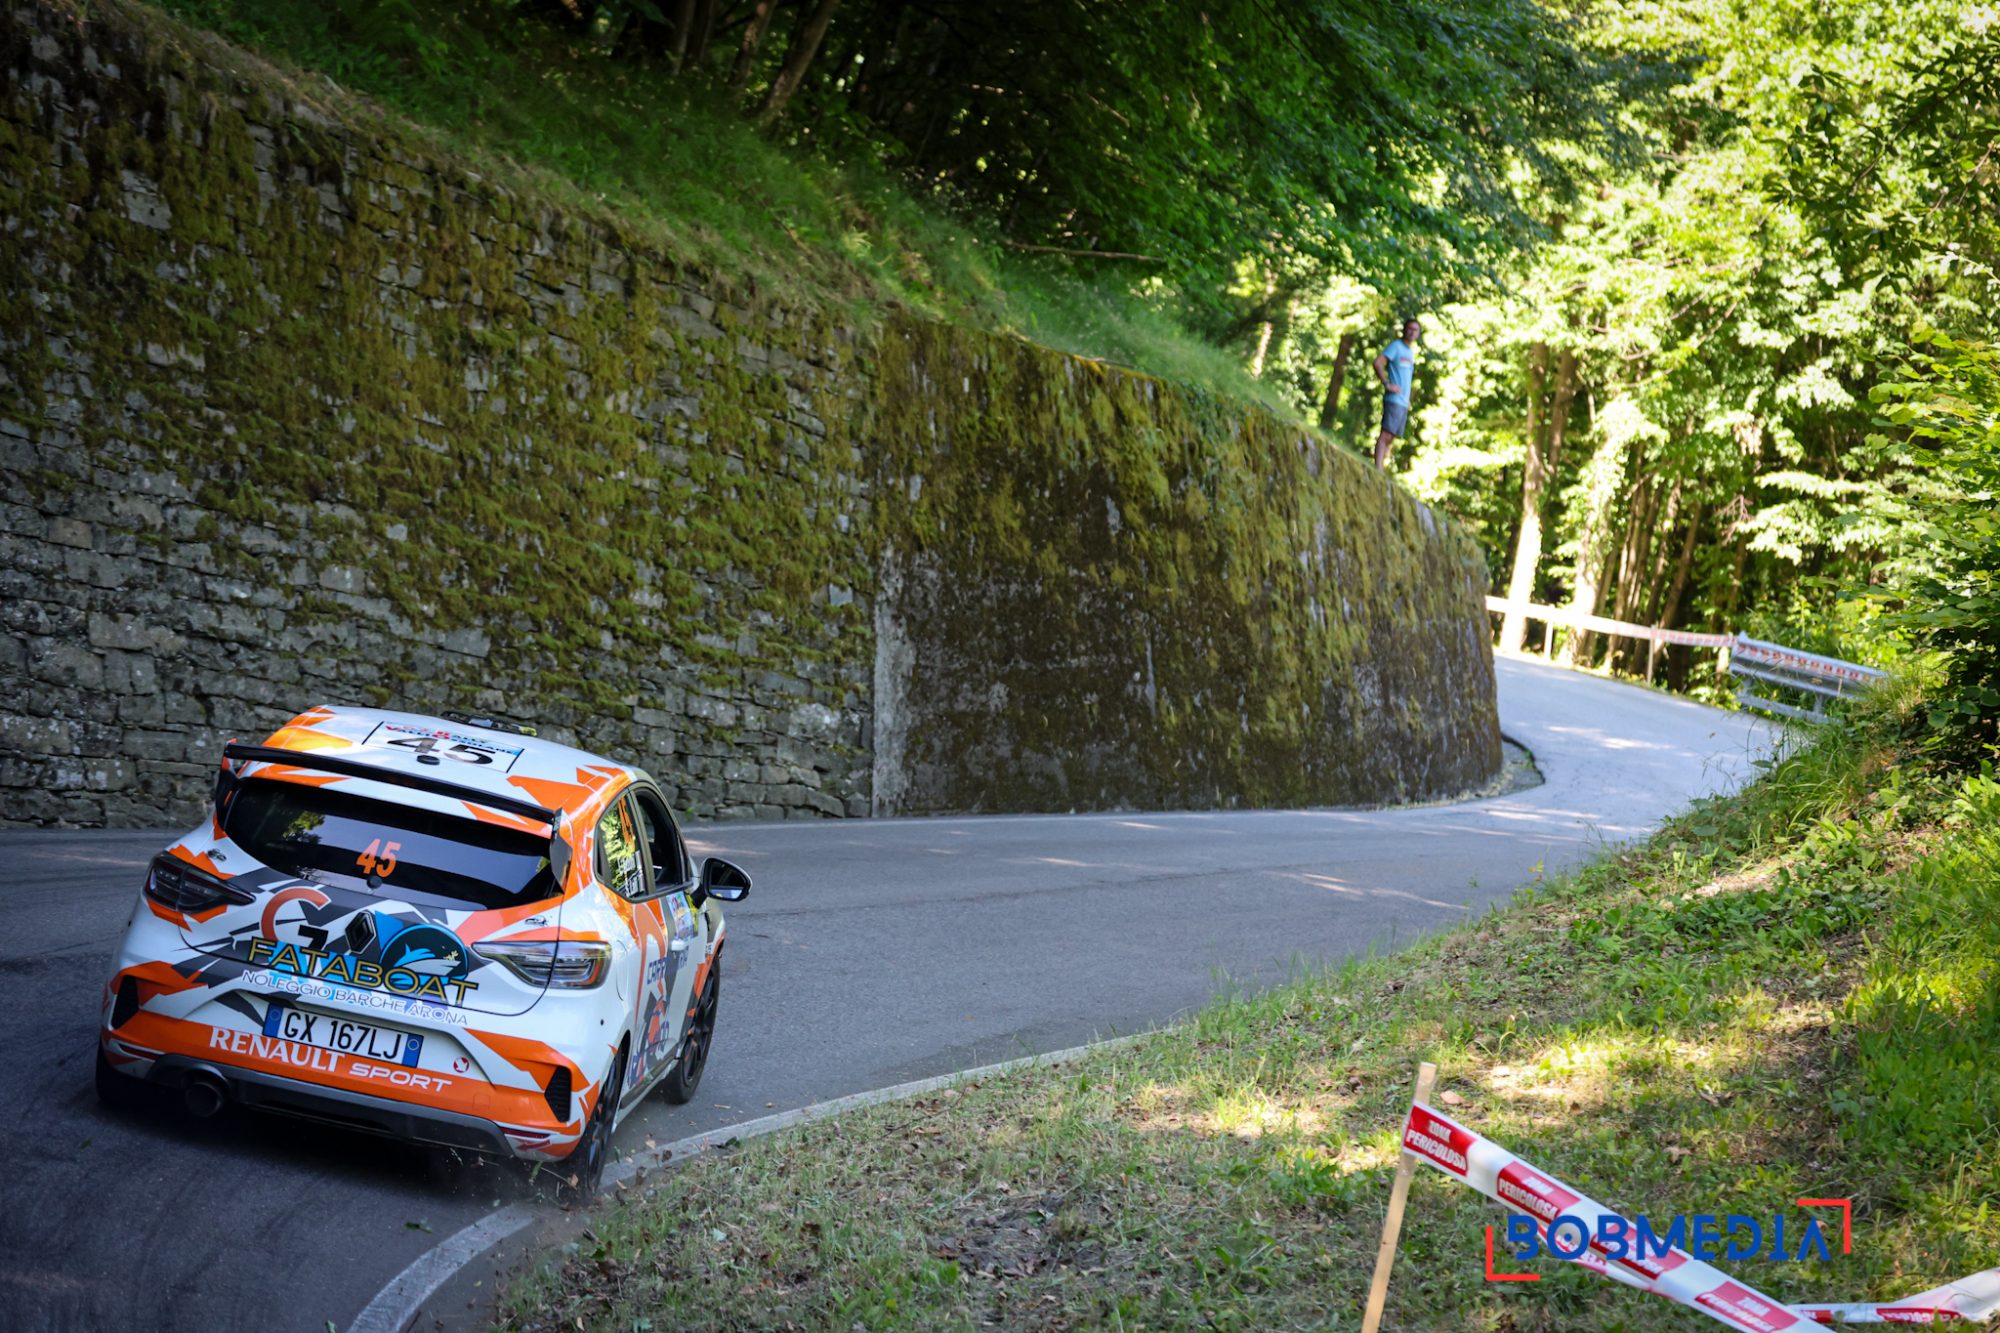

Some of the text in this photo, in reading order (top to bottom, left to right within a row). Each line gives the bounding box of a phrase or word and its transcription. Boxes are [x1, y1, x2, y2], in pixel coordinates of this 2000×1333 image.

[387, 737, 496, 765] 45
[355, 838, 401, 878] 45
[248, 936, 479, 1007] FATABOAT
[242, 969, 468, 1026] NOLEGGIO BARCHE ARONA
[284, 1011, 403, 1060] GX 167LJ
[209, 1026, 453, 1093] RENAULT SPORT
[1406, 1129, 1467, 1171] PERICOLOSA
[1498, 1178, 1559, 1220] PERICOLOSA
